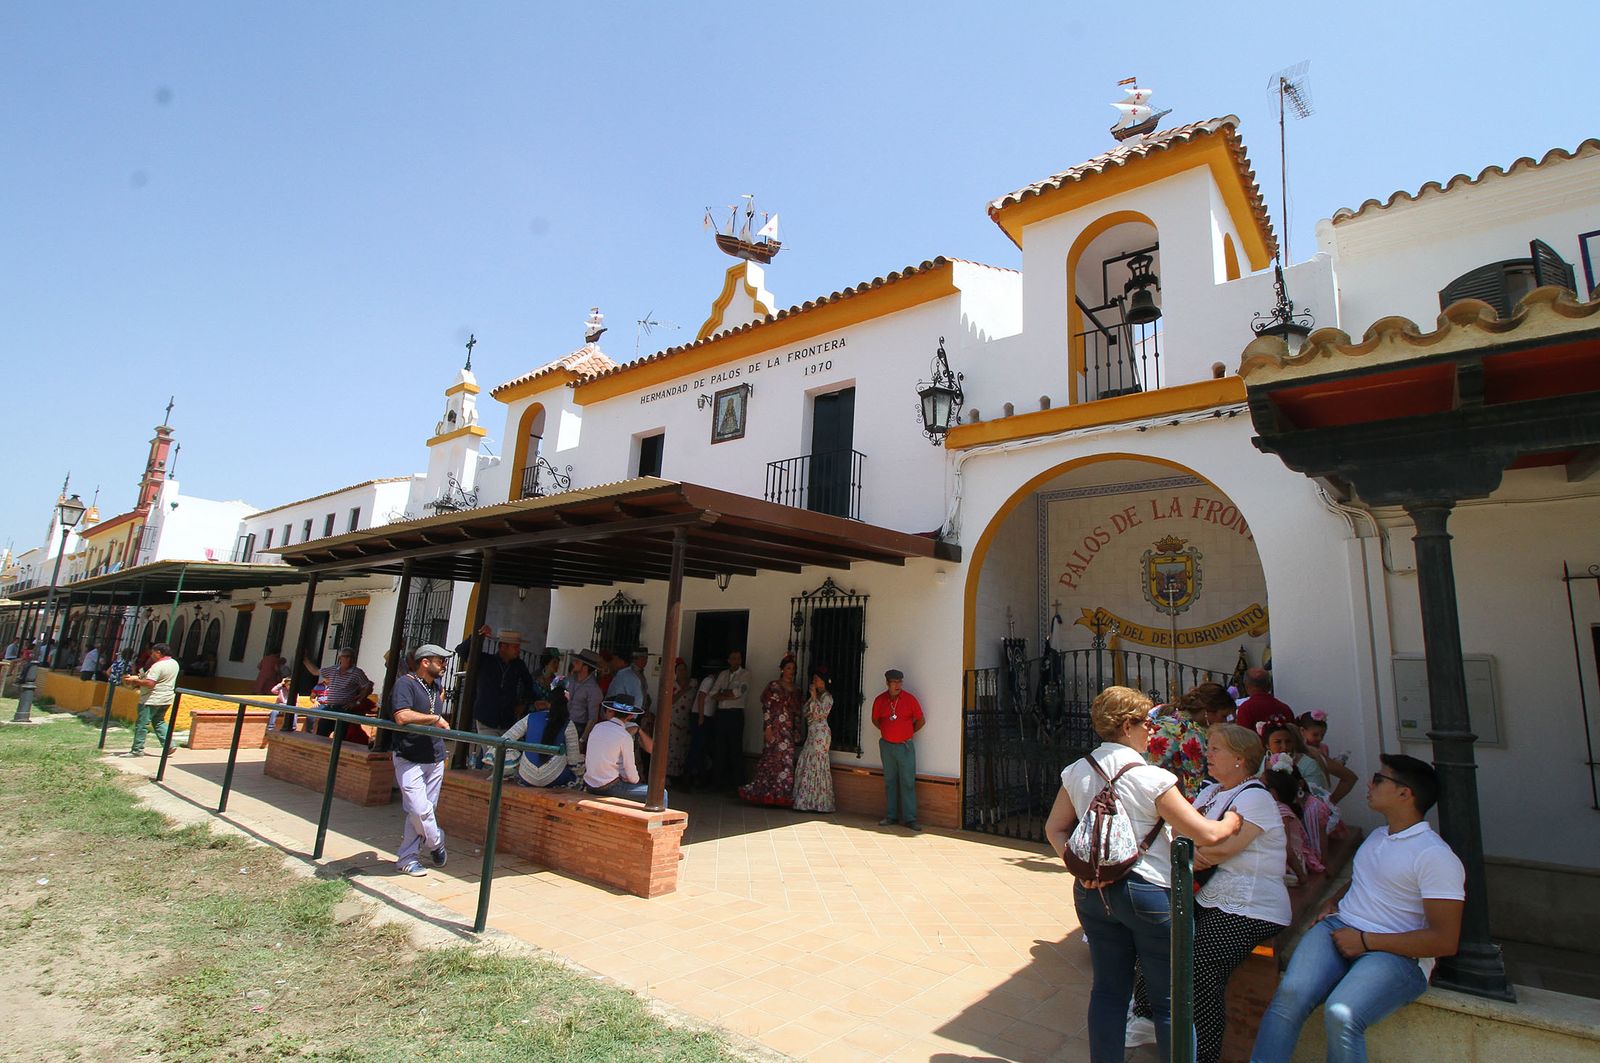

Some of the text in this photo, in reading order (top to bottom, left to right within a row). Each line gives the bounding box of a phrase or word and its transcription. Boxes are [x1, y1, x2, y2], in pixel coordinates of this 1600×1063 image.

[640, 337, 846, 404] HERMANDAD DE PALOS DE LA FRONTERA
[804, 360, 833, 376] 1970
[1059, 496, 1254, 591] PALOS DE LA FRON
[1123, 625, 1144, 641] DEL
[1151, 607, 1265, 645] DESCUBRIMIENTO
